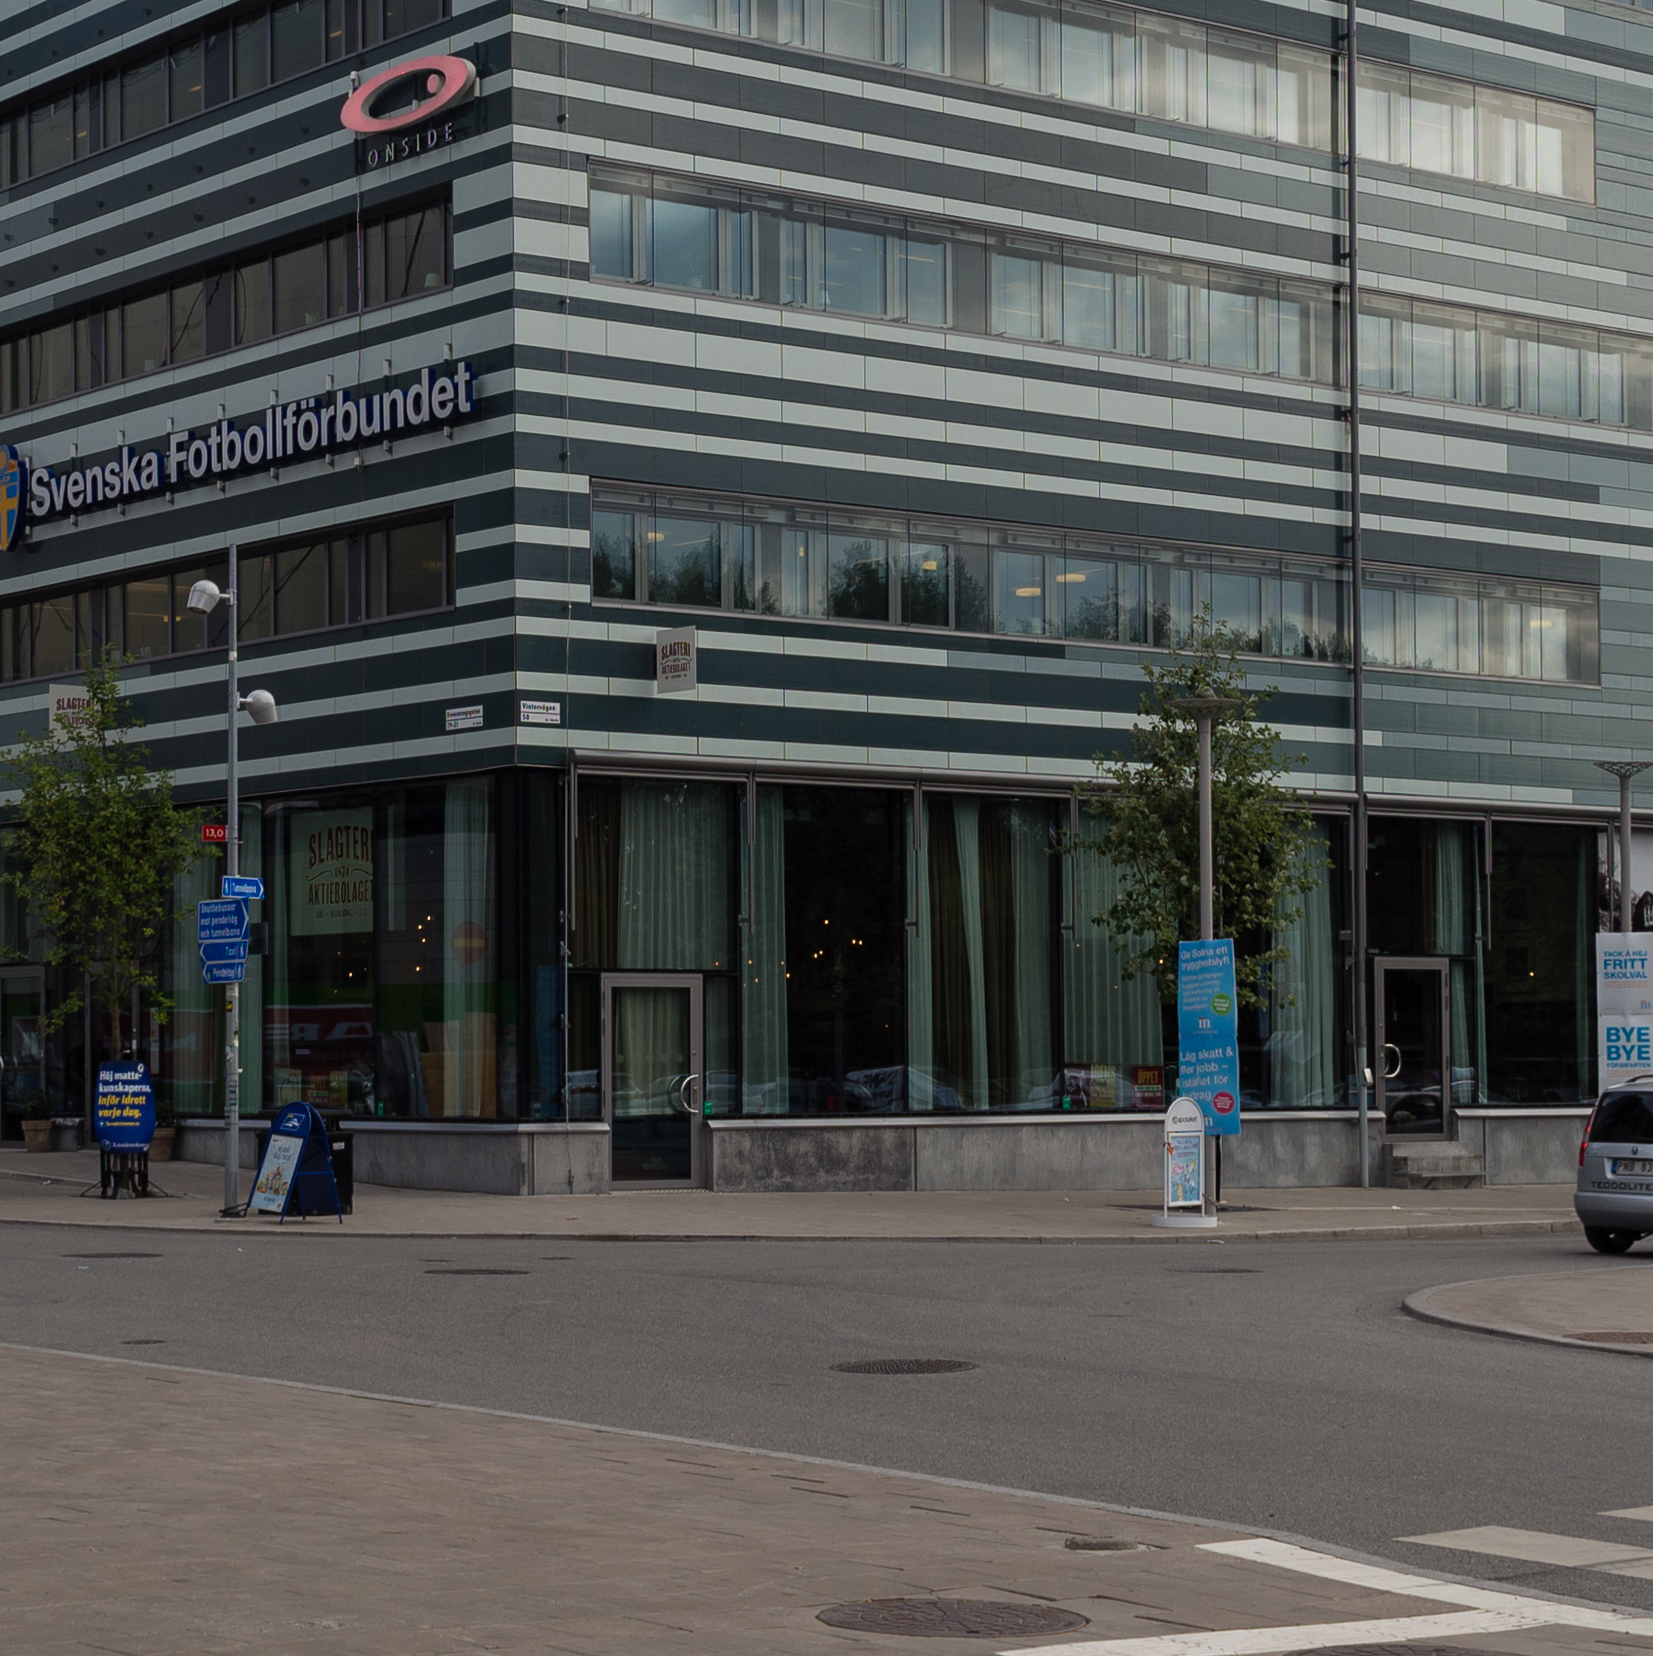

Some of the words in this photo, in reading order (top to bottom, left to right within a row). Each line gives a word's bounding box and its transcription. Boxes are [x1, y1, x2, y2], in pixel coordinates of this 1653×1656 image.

[367, 122, 453, 167] ONSIDE
[30, 445, 159, 516] Svenska
[169, 362, 477, 483] Fotbollförbundet
[661, 641, 691, 660] SLAGTERI
[308, 825, 374, 870] SLAGTERI
[308, 880, 374, 906] AKTIEBOLAGET
[1191, 947, 1214, 958] Solna
[1215, 945, 1228, 954] ett
[1603, 958, 1648, 970] FRITT
[1603, 971, 1648, 979] SKOLVAL
[1606, 1027, 1650, 1042] BYE
[1180, 1052, 1196, 1063] Låg
[1198, 1048, 1224, 1060] skatt
[1225, 1046, 1234, 1057] &
[1607, 1045, 1650, 1060] BYE
[99, 1070, 113, 1082] Höj
[1196, 1063, 1219, 1076] jobb
[1214, 1075, 1229, 1085] för
[98, 1094, 120, 1106] inför
[98, 1107, 122, 1119] varje
[123, 1106, 143, 1119] dag.
